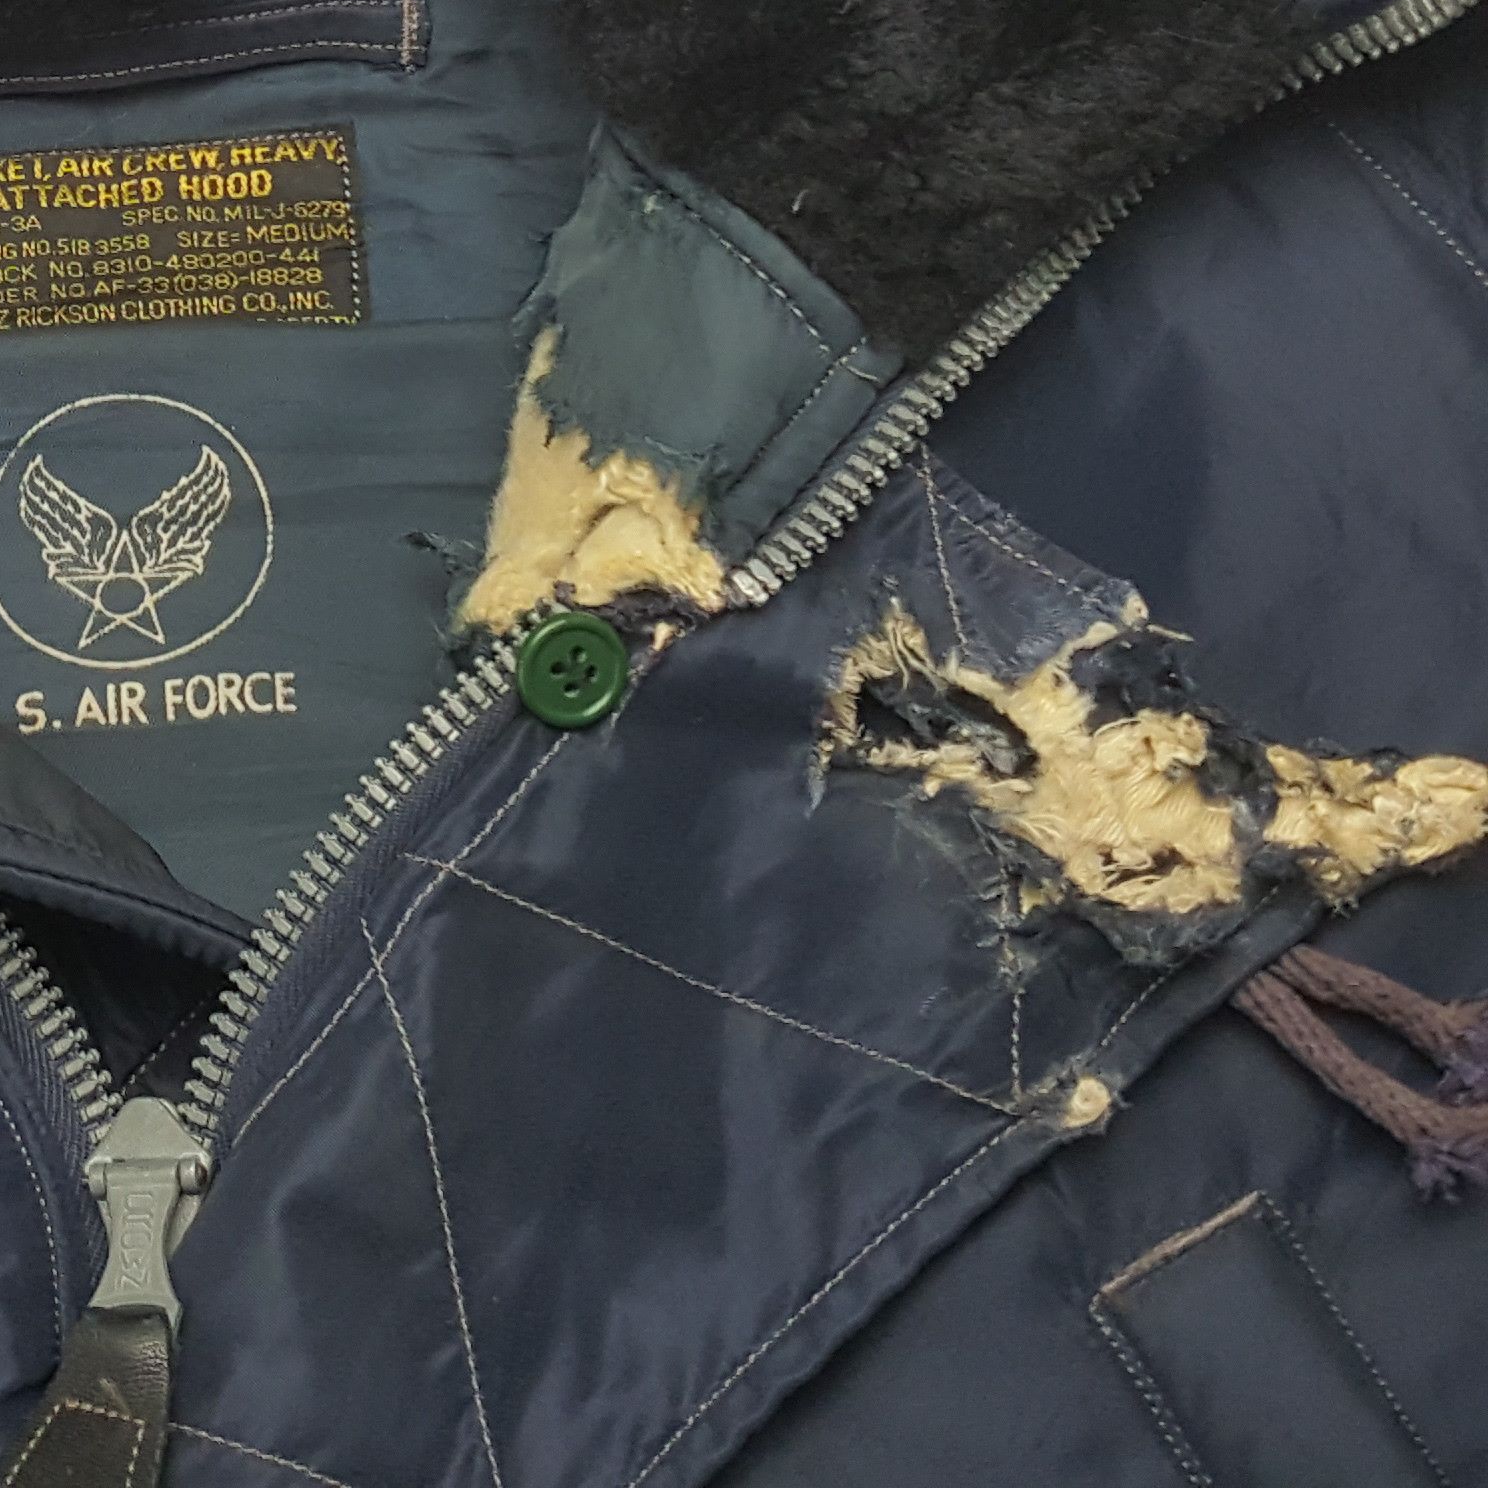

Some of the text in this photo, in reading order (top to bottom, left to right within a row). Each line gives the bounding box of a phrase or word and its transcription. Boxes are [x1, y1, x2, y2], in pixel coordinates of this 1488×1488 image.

[178, 168, 273, 201] HOOD
[246, 222, 349, 245] MEDIUM
[16, 302, 117, 329] RICKSON
[120, 293, 237, 322] CLOTHING
[74, 680, 150, 728] AIR
[164, 671, 299, 723] FORCE
